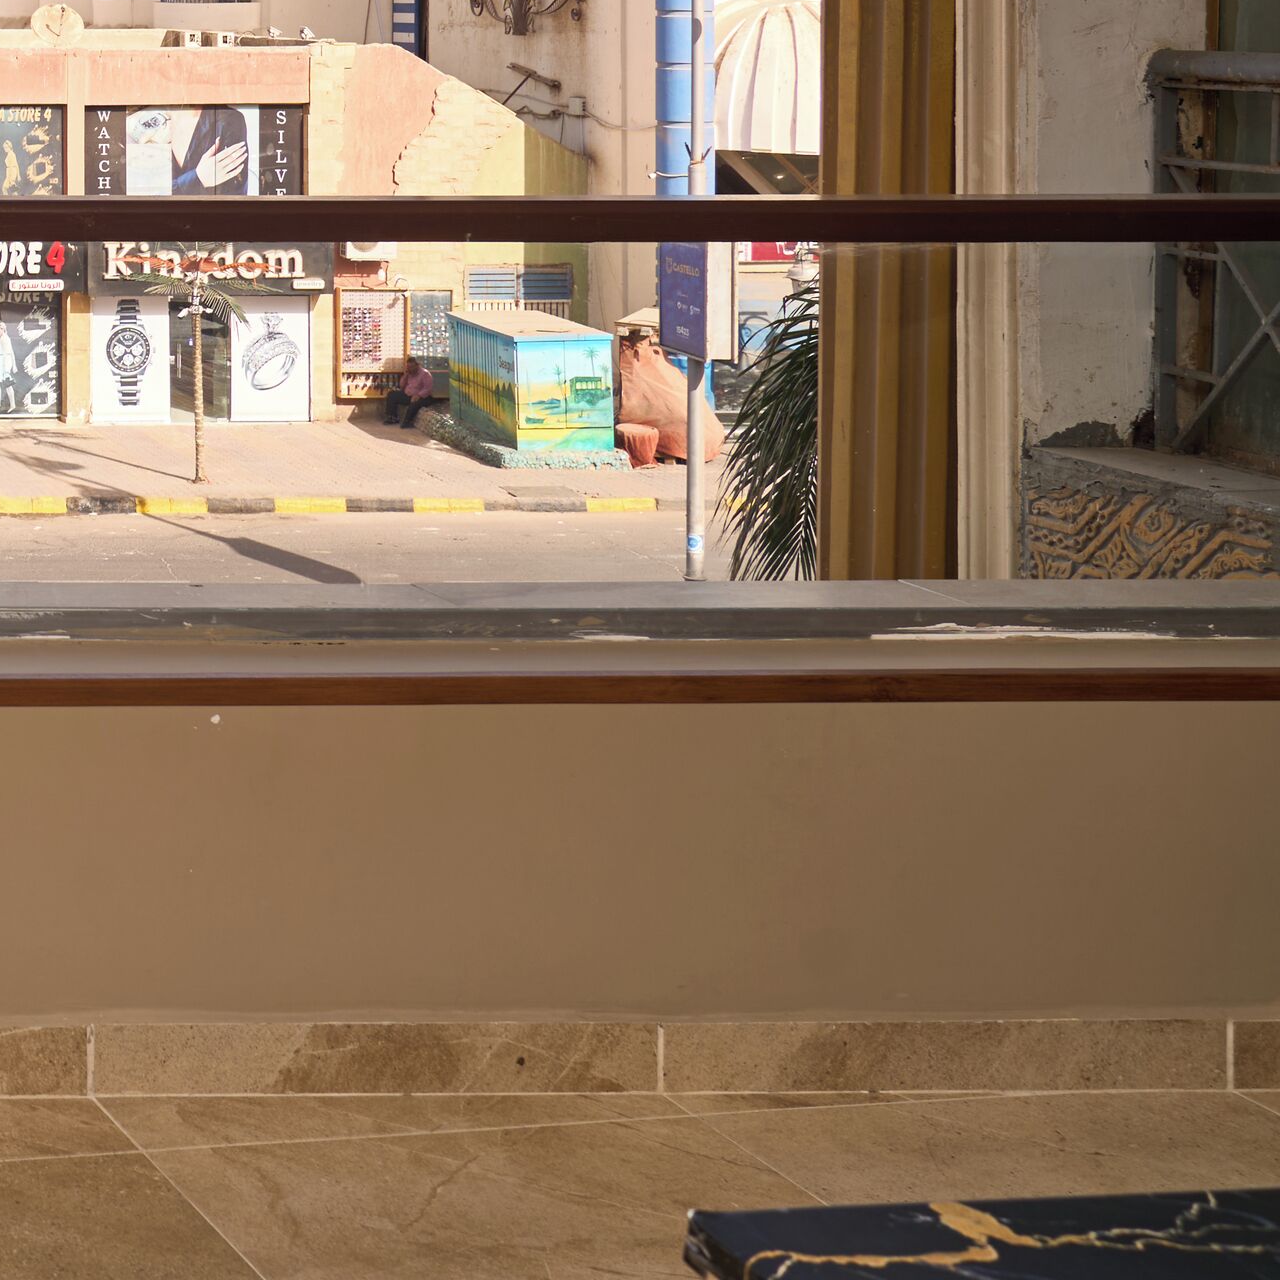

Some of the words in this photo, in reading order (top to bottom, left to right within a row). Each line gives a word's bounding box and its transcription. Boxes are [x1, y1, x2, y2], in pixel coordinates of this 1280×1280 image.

[7, 107, 41, 123] STORE
[43, 107, 52, 122] 4
[97, 111, 111, 196] WATCH
[45, 241, 65, 274] 4
